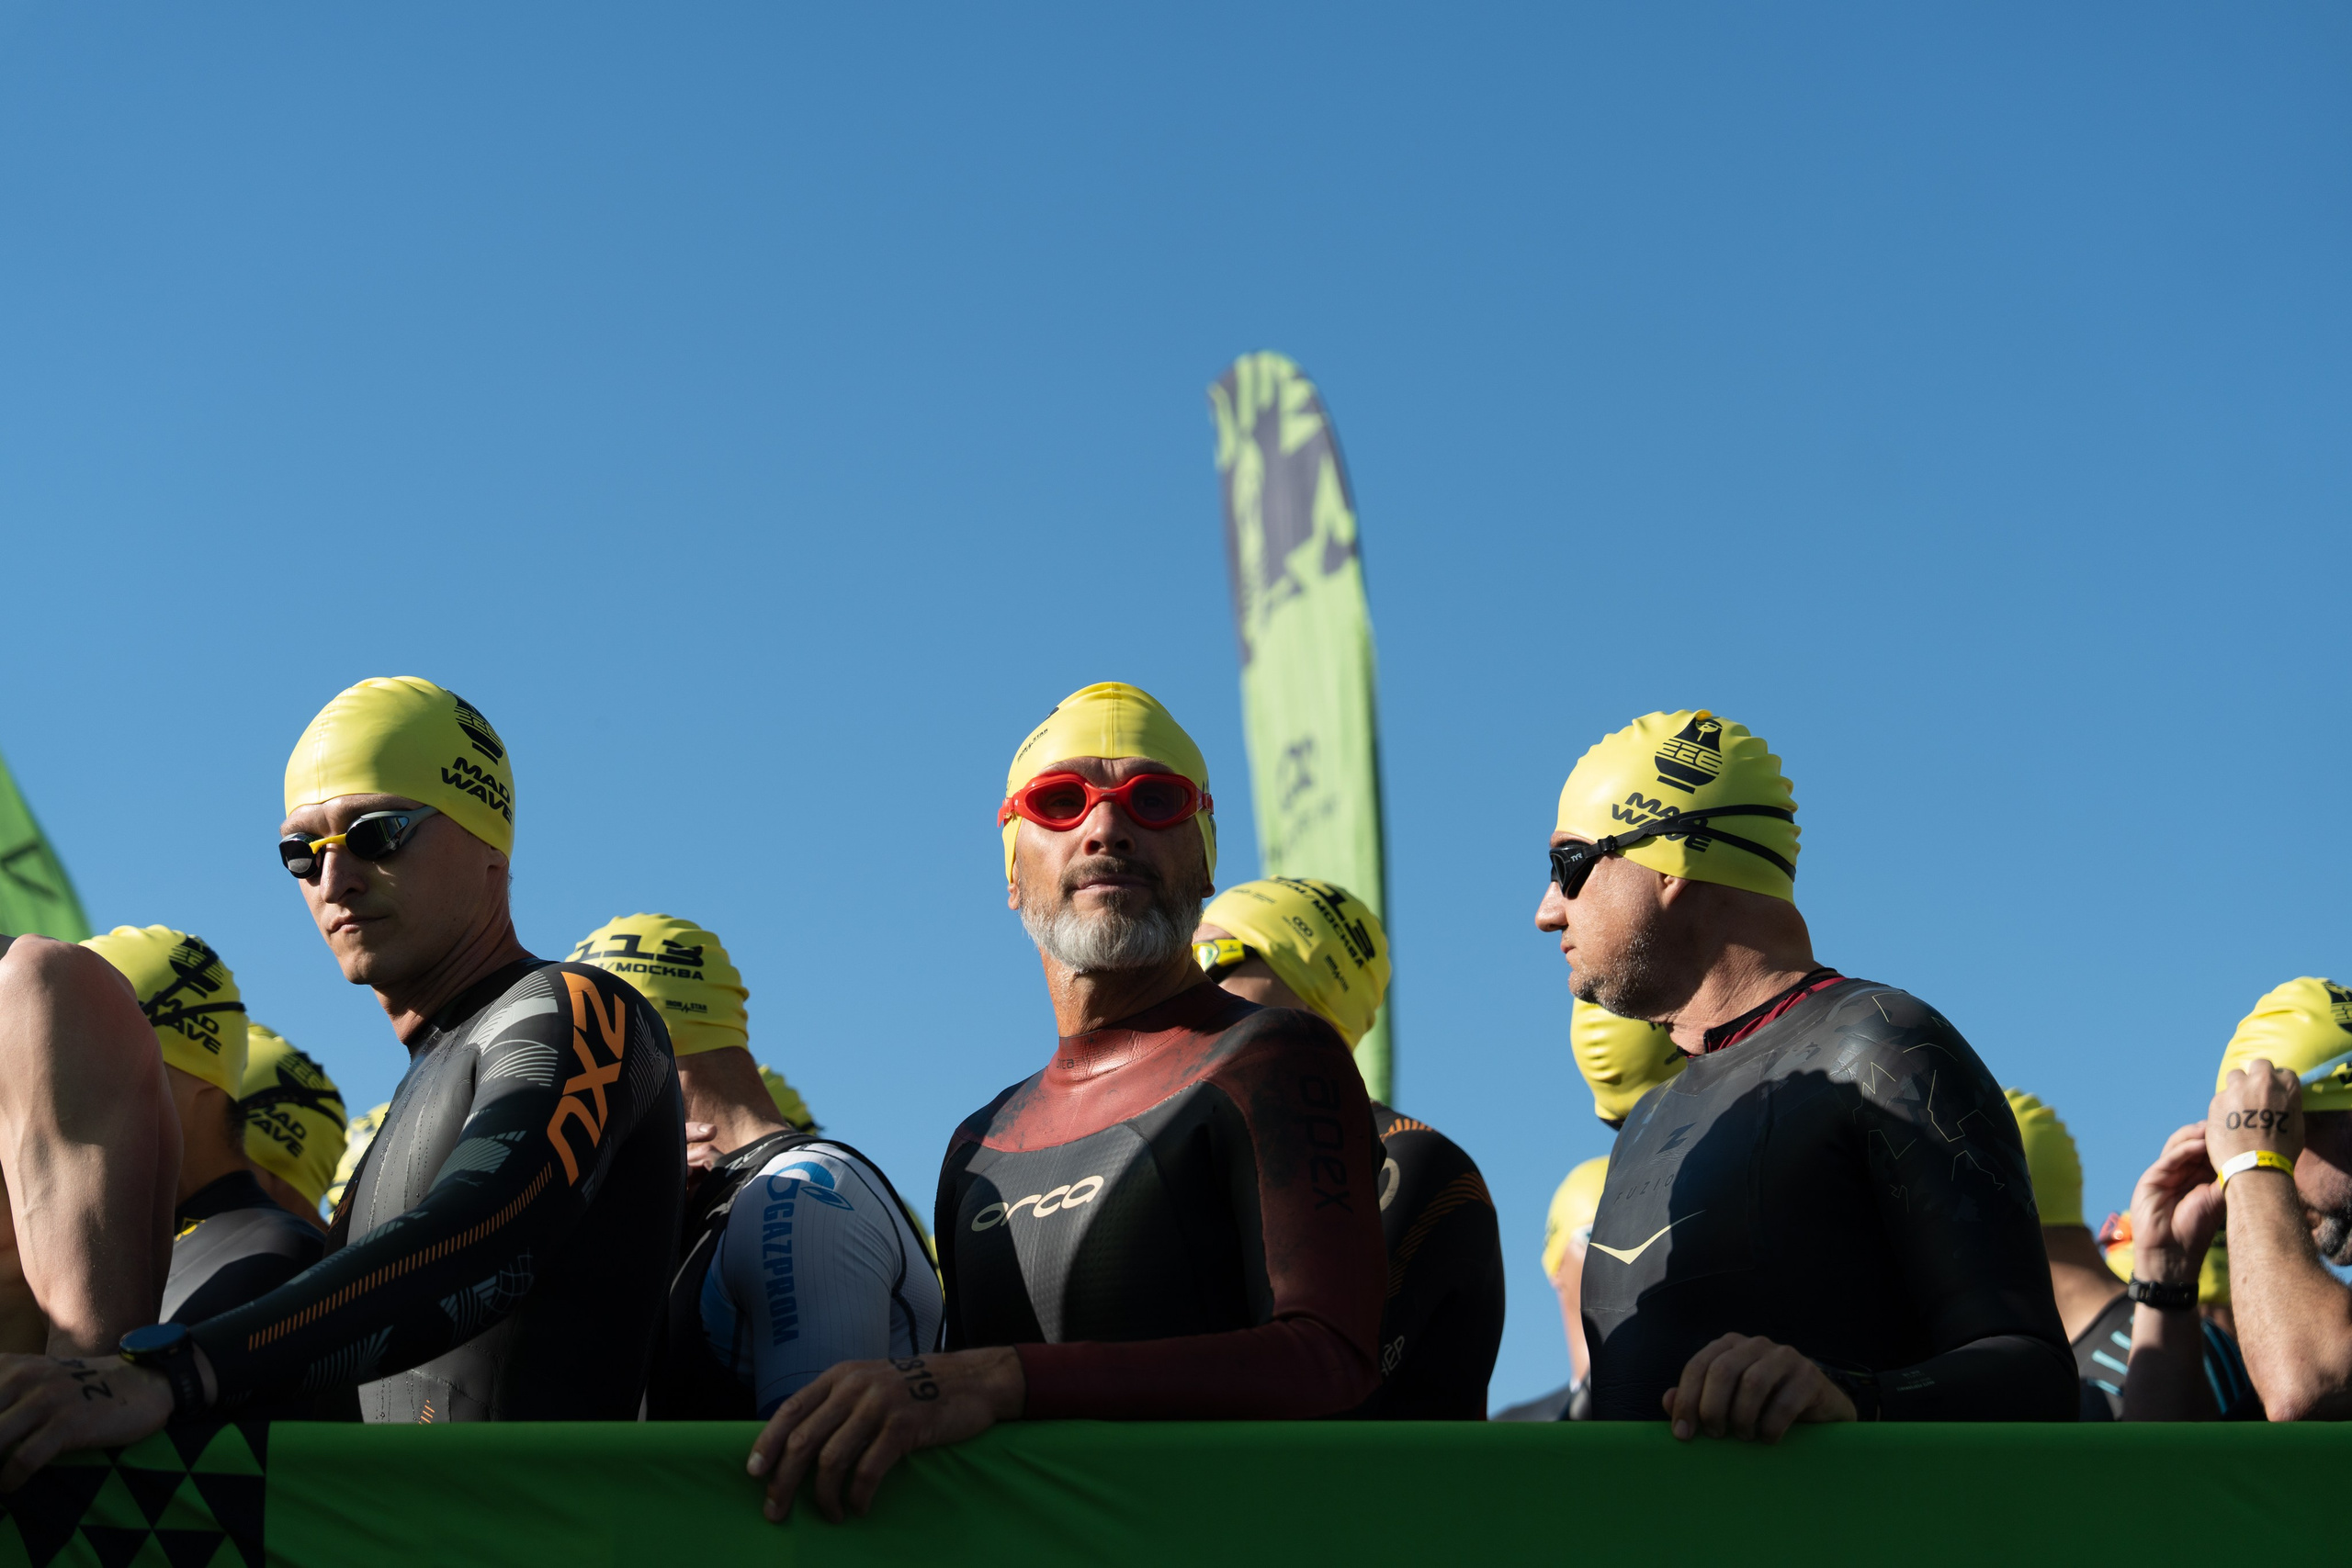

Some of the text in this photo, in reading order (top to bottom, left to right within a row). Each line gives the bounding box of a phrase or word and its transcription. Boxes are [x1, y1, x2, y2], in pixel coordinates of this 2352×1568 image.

[440, 766, 513, 826] WAVE
[452, 756, 511, 804] MAD
[1611, 803, 1713, 853] WE
[1570, 852, 1583, 862] TYR
[690, 1001, 707, 1011] STAR
[547, 971, 626, 1188] 2XU
[1295, 1075, 1354, 1214] apex
[2225, 1108, 2290, 1134] 2620
[970, 1175, 1104, 1232] orca
[762, 1201, 799, 1348] GAZPROM
